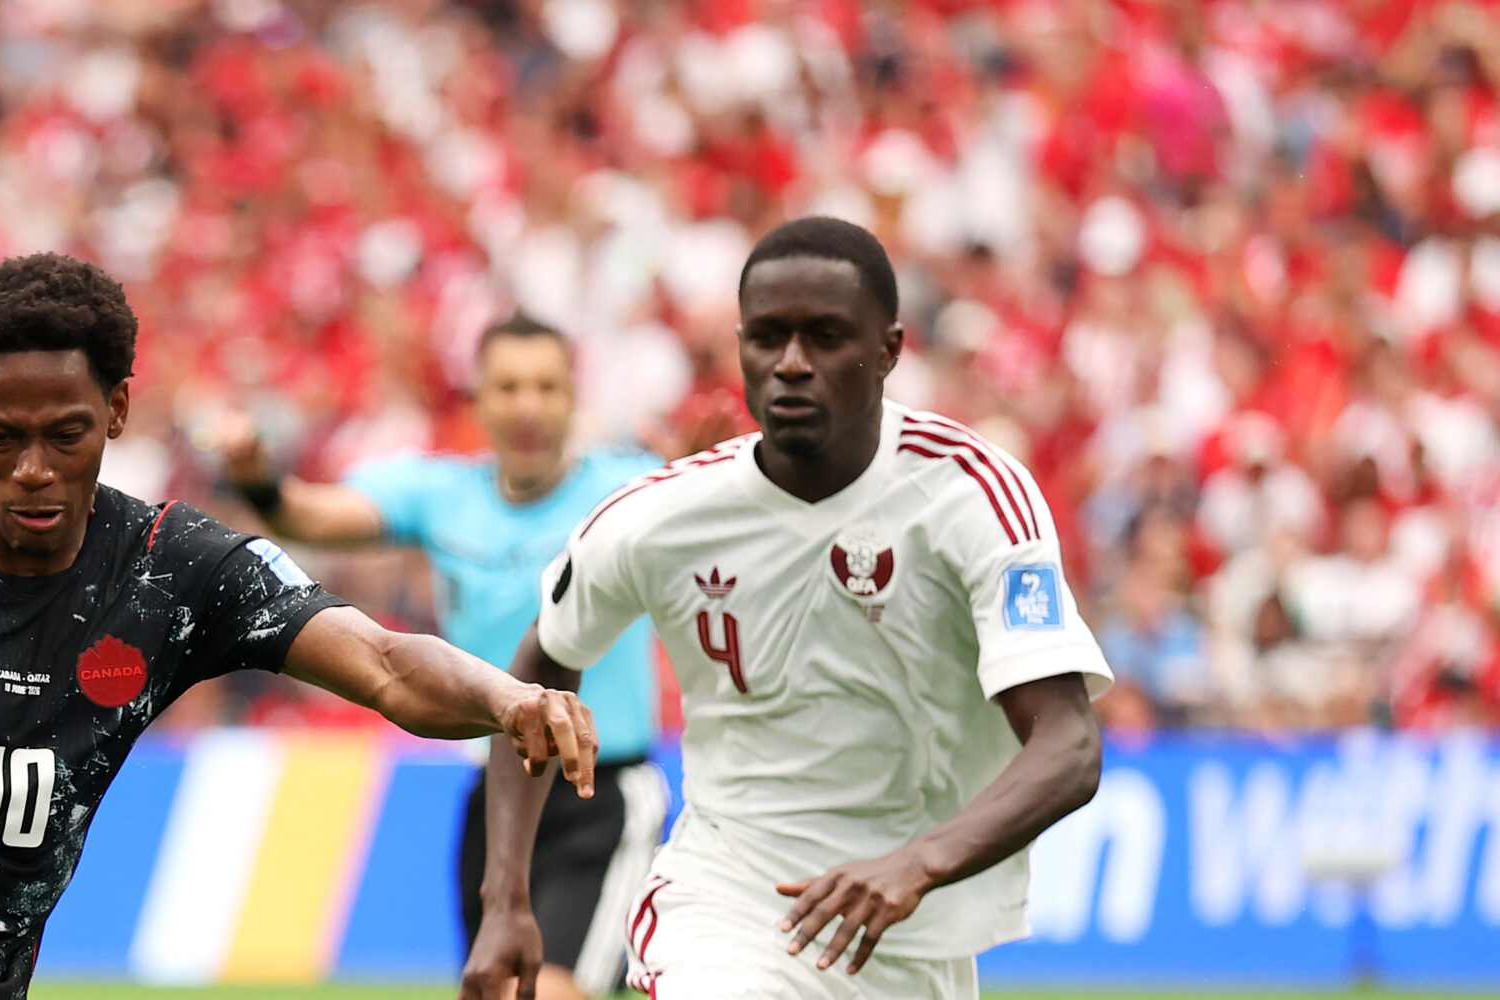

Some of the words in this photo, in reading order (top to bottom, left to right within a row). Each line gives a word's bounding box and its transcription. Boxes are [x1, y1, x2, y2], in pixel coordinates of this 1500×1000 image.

[697, 611, 747, 694] 4
[27, 674, 50, 683] QATAR
[81, 666, 142, 680] CANADA
